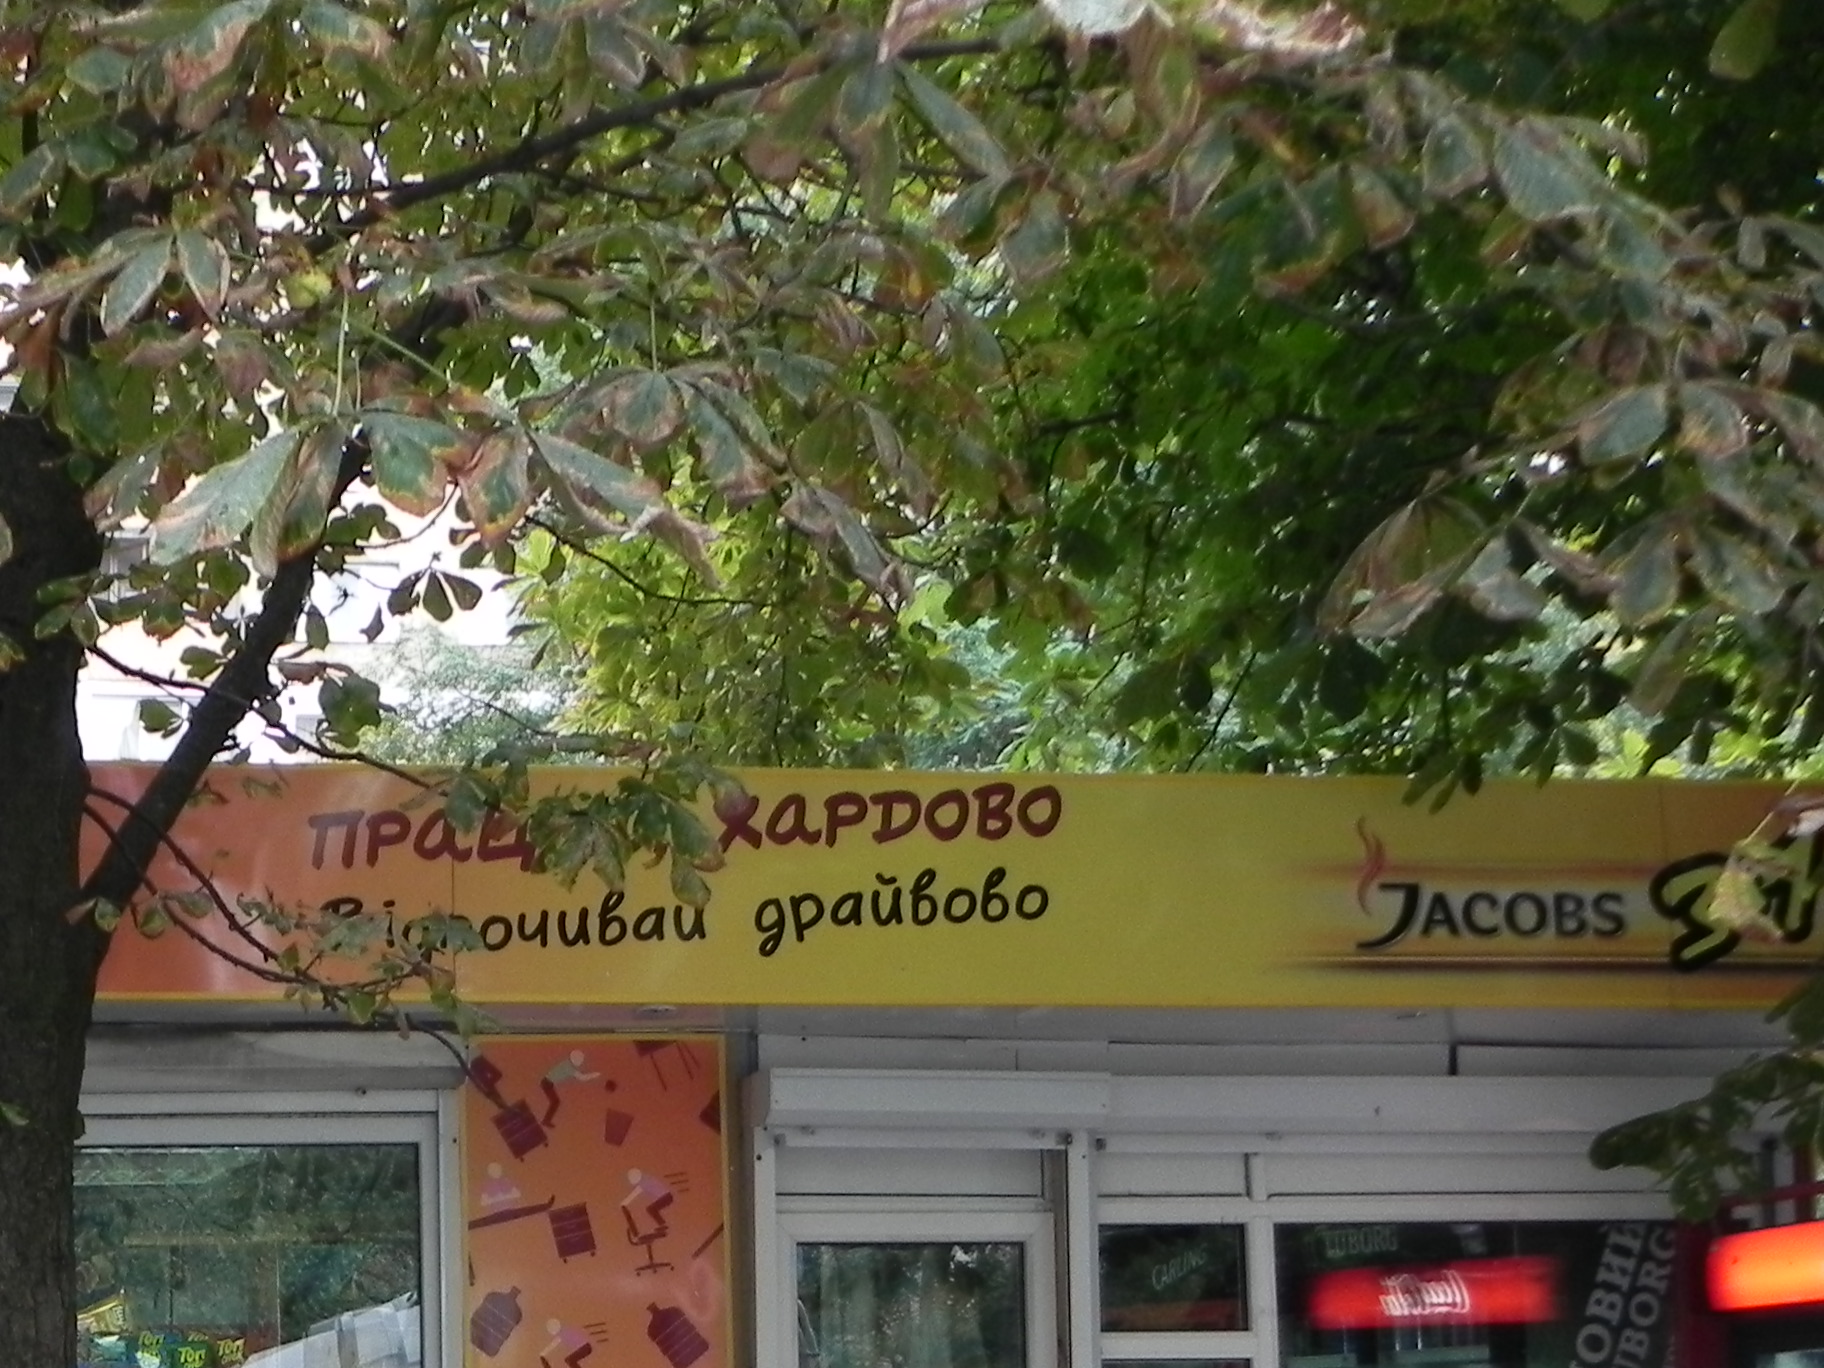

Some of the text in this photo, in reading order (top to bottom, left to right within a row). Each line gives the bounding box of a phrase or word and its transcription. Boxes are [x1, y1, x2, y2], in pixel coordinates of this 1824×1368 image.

[307, 782, 1063, 873] ПРАЦ ХАРДОВО
[754, 866, 1050, 958] драйвово
[1356, 882, 1627, 952] JACOBS
